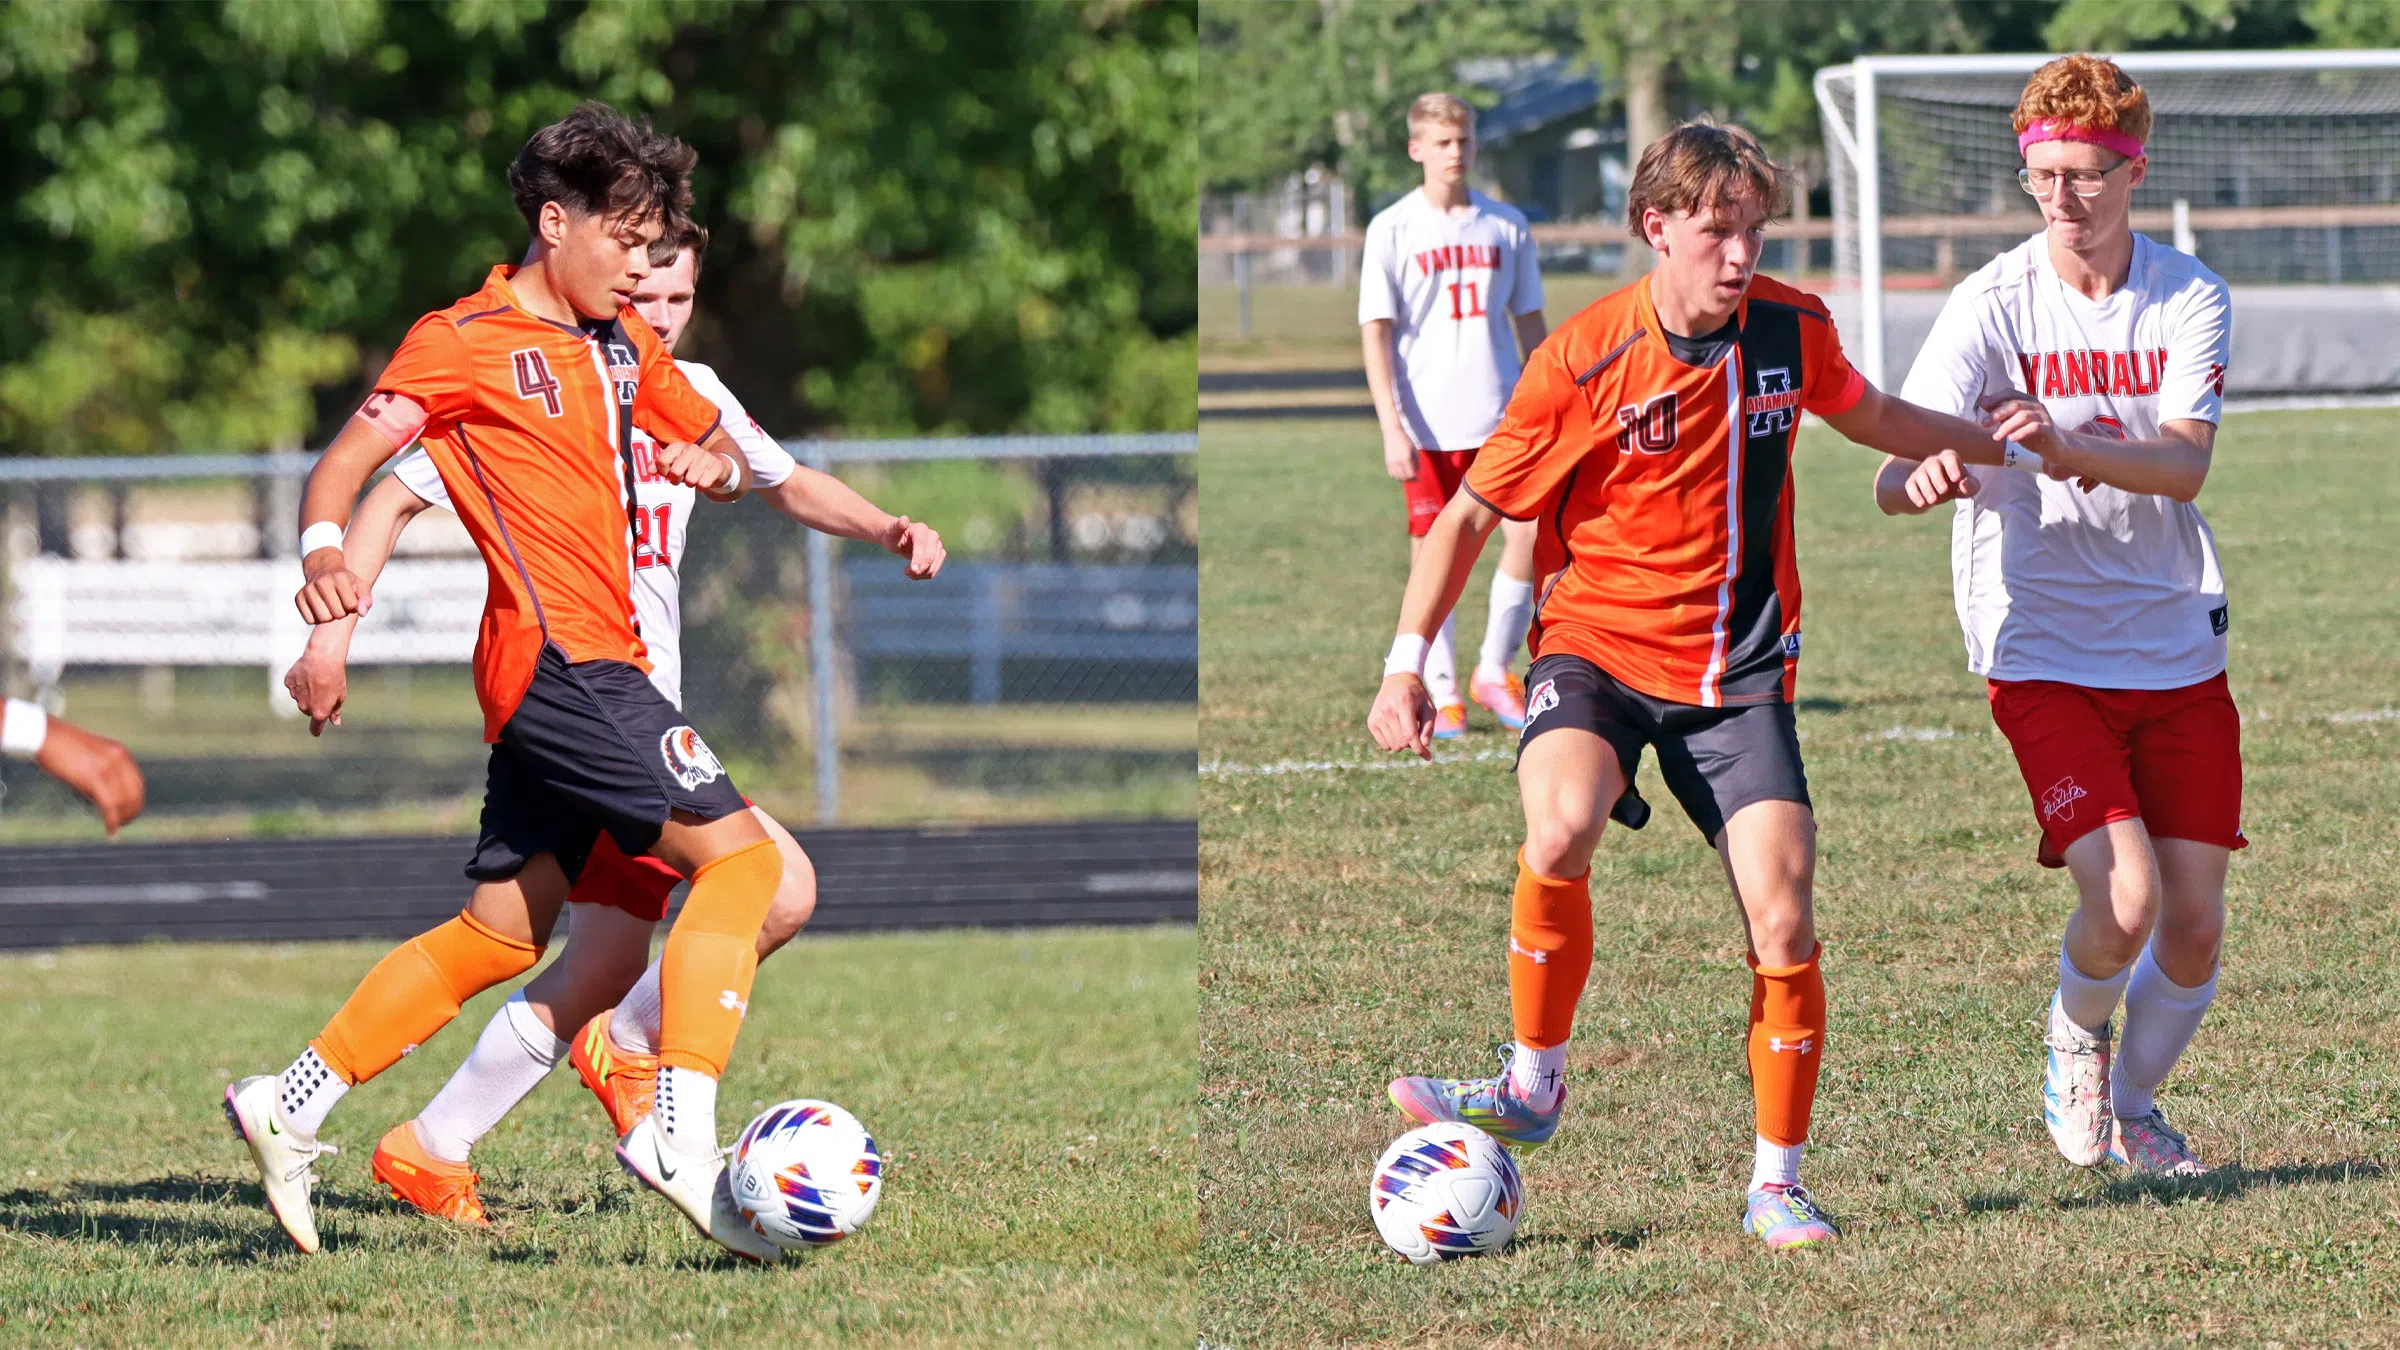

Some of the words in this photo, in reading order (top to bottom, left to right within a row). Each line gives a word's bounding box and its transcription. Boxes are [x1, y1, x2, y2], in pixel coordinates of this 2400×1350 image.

[1447, 282, 1486, 320] 11
[510, 347, 563, 418] 4
[1746, 388, 1801, 415] ALTAMONT
[1749, 367, 1794, 438] A
[1616, 391, 1679, 455] 10
[634, 503, 671, 570] 21
